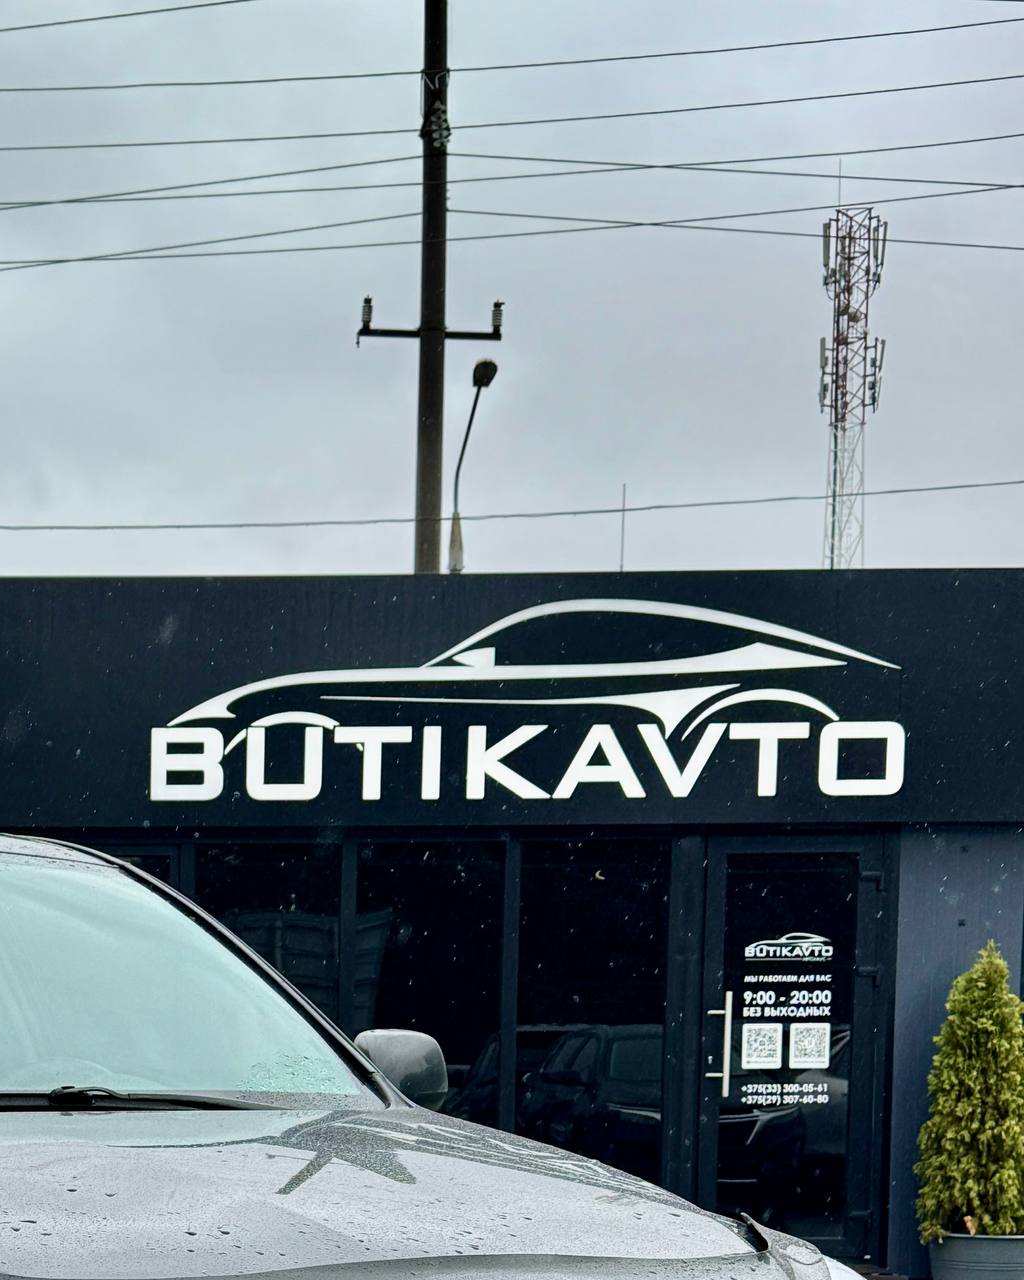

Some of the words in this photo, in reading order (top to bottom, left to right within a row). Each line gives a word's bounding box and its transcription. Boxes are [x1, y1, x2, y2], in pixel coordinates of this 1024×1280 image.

[150, 721, 904, 801] BUTIKAVTO
[744, 946, 834, 957] BUTIKAVTO
[744, 975, 758, 983] МЫ
[759, 975, 798, 983] РАБОТАЕМ
[799, 974, 815, 983] ДЛЯ
[816, 974, 832, 982] ВАС
[743, 990, 776, 1005] 9:00
[790, 990, 832, 1005] 20:00
[742, 1006, 762, 1017] БЕЗ
[764, 1006, 831, 1018] ВЫХОДНЫХ
[741, 1083, 781, 1094] +375(33)
